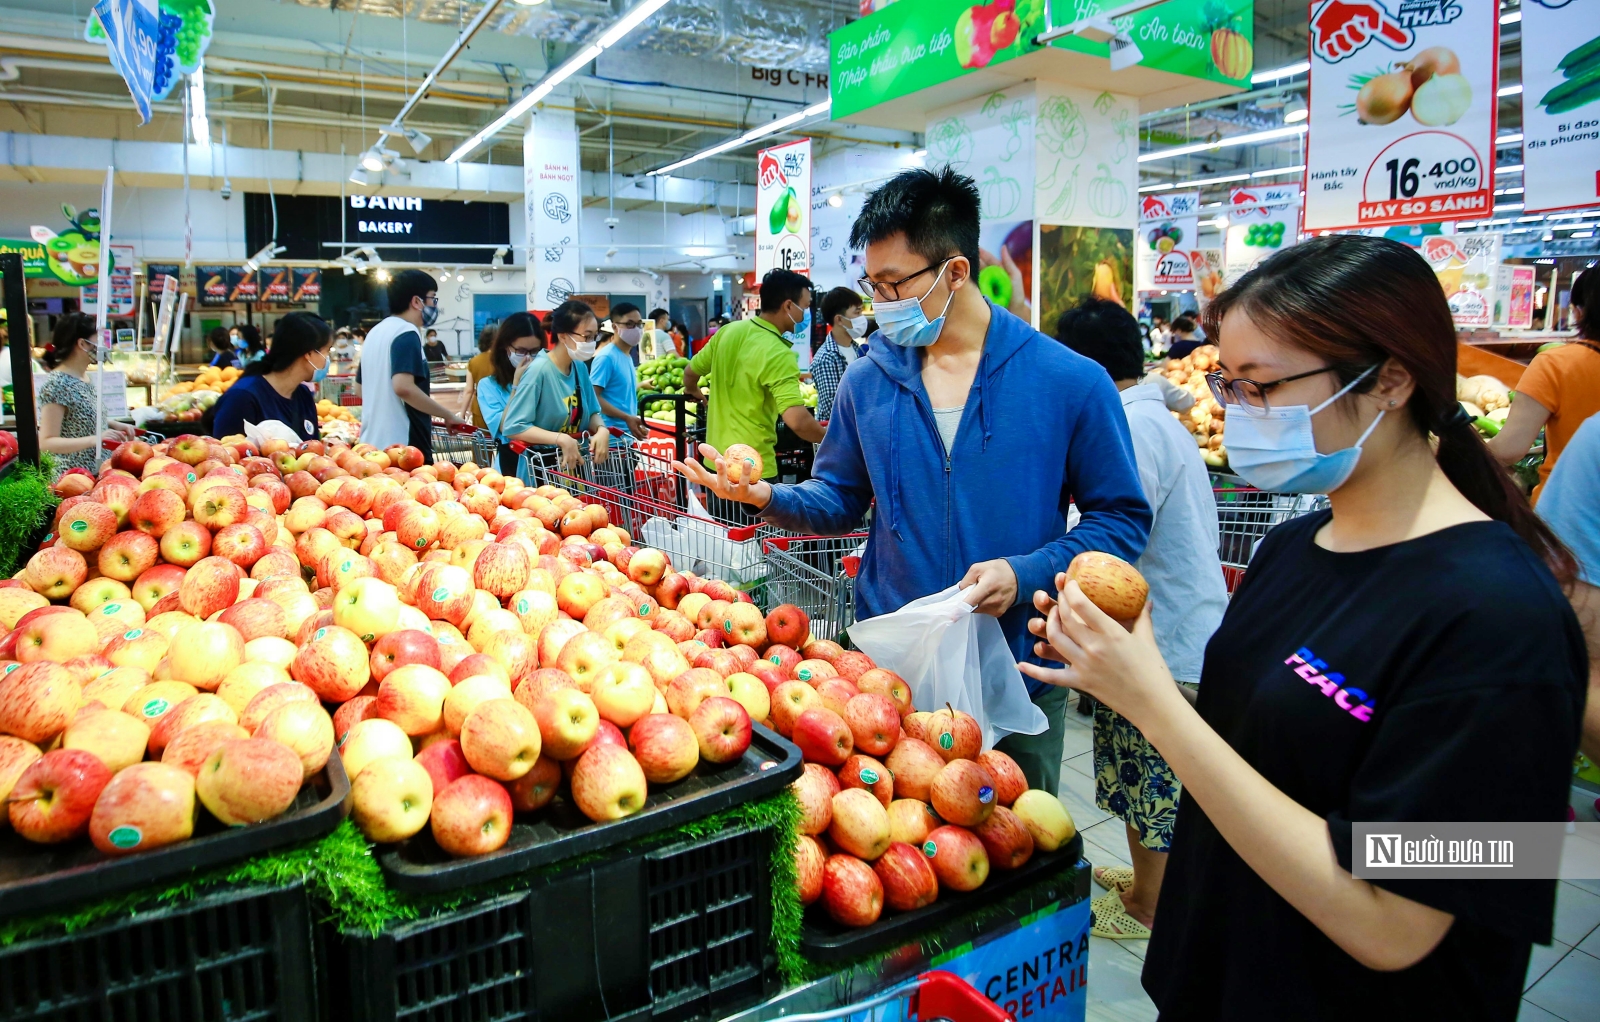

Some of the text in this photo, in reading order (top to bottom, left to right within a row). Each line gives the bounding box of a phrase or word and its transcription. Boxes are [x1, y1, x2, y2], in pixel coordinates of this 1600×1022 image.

[837, 24, 891, 64] Sản phẩm
[1140, 17, 1204, 49] An toàn
[752, 66, 781, 86] Big
[787, 69, 799, 85] C
[838, 66, 867, 94] Nhập
[929, 27, 951, 56] tiếp
[1528, 131, 1599, 149] địa phương
[1311, 167, 1357, 180] Hành tây
[1386, 157, 1476, 200] 16.400
[1400, 201, 1426, 215] SO
[1430, 195, 1485, 213] SÁNH
[359, 221, 413, 234] BAKERY
[1284, 646, 1376, 722] PEACE
[985, 932, 1089, 1002] CENTRA
[1003, 964, 1087, 1022] RETAIL
